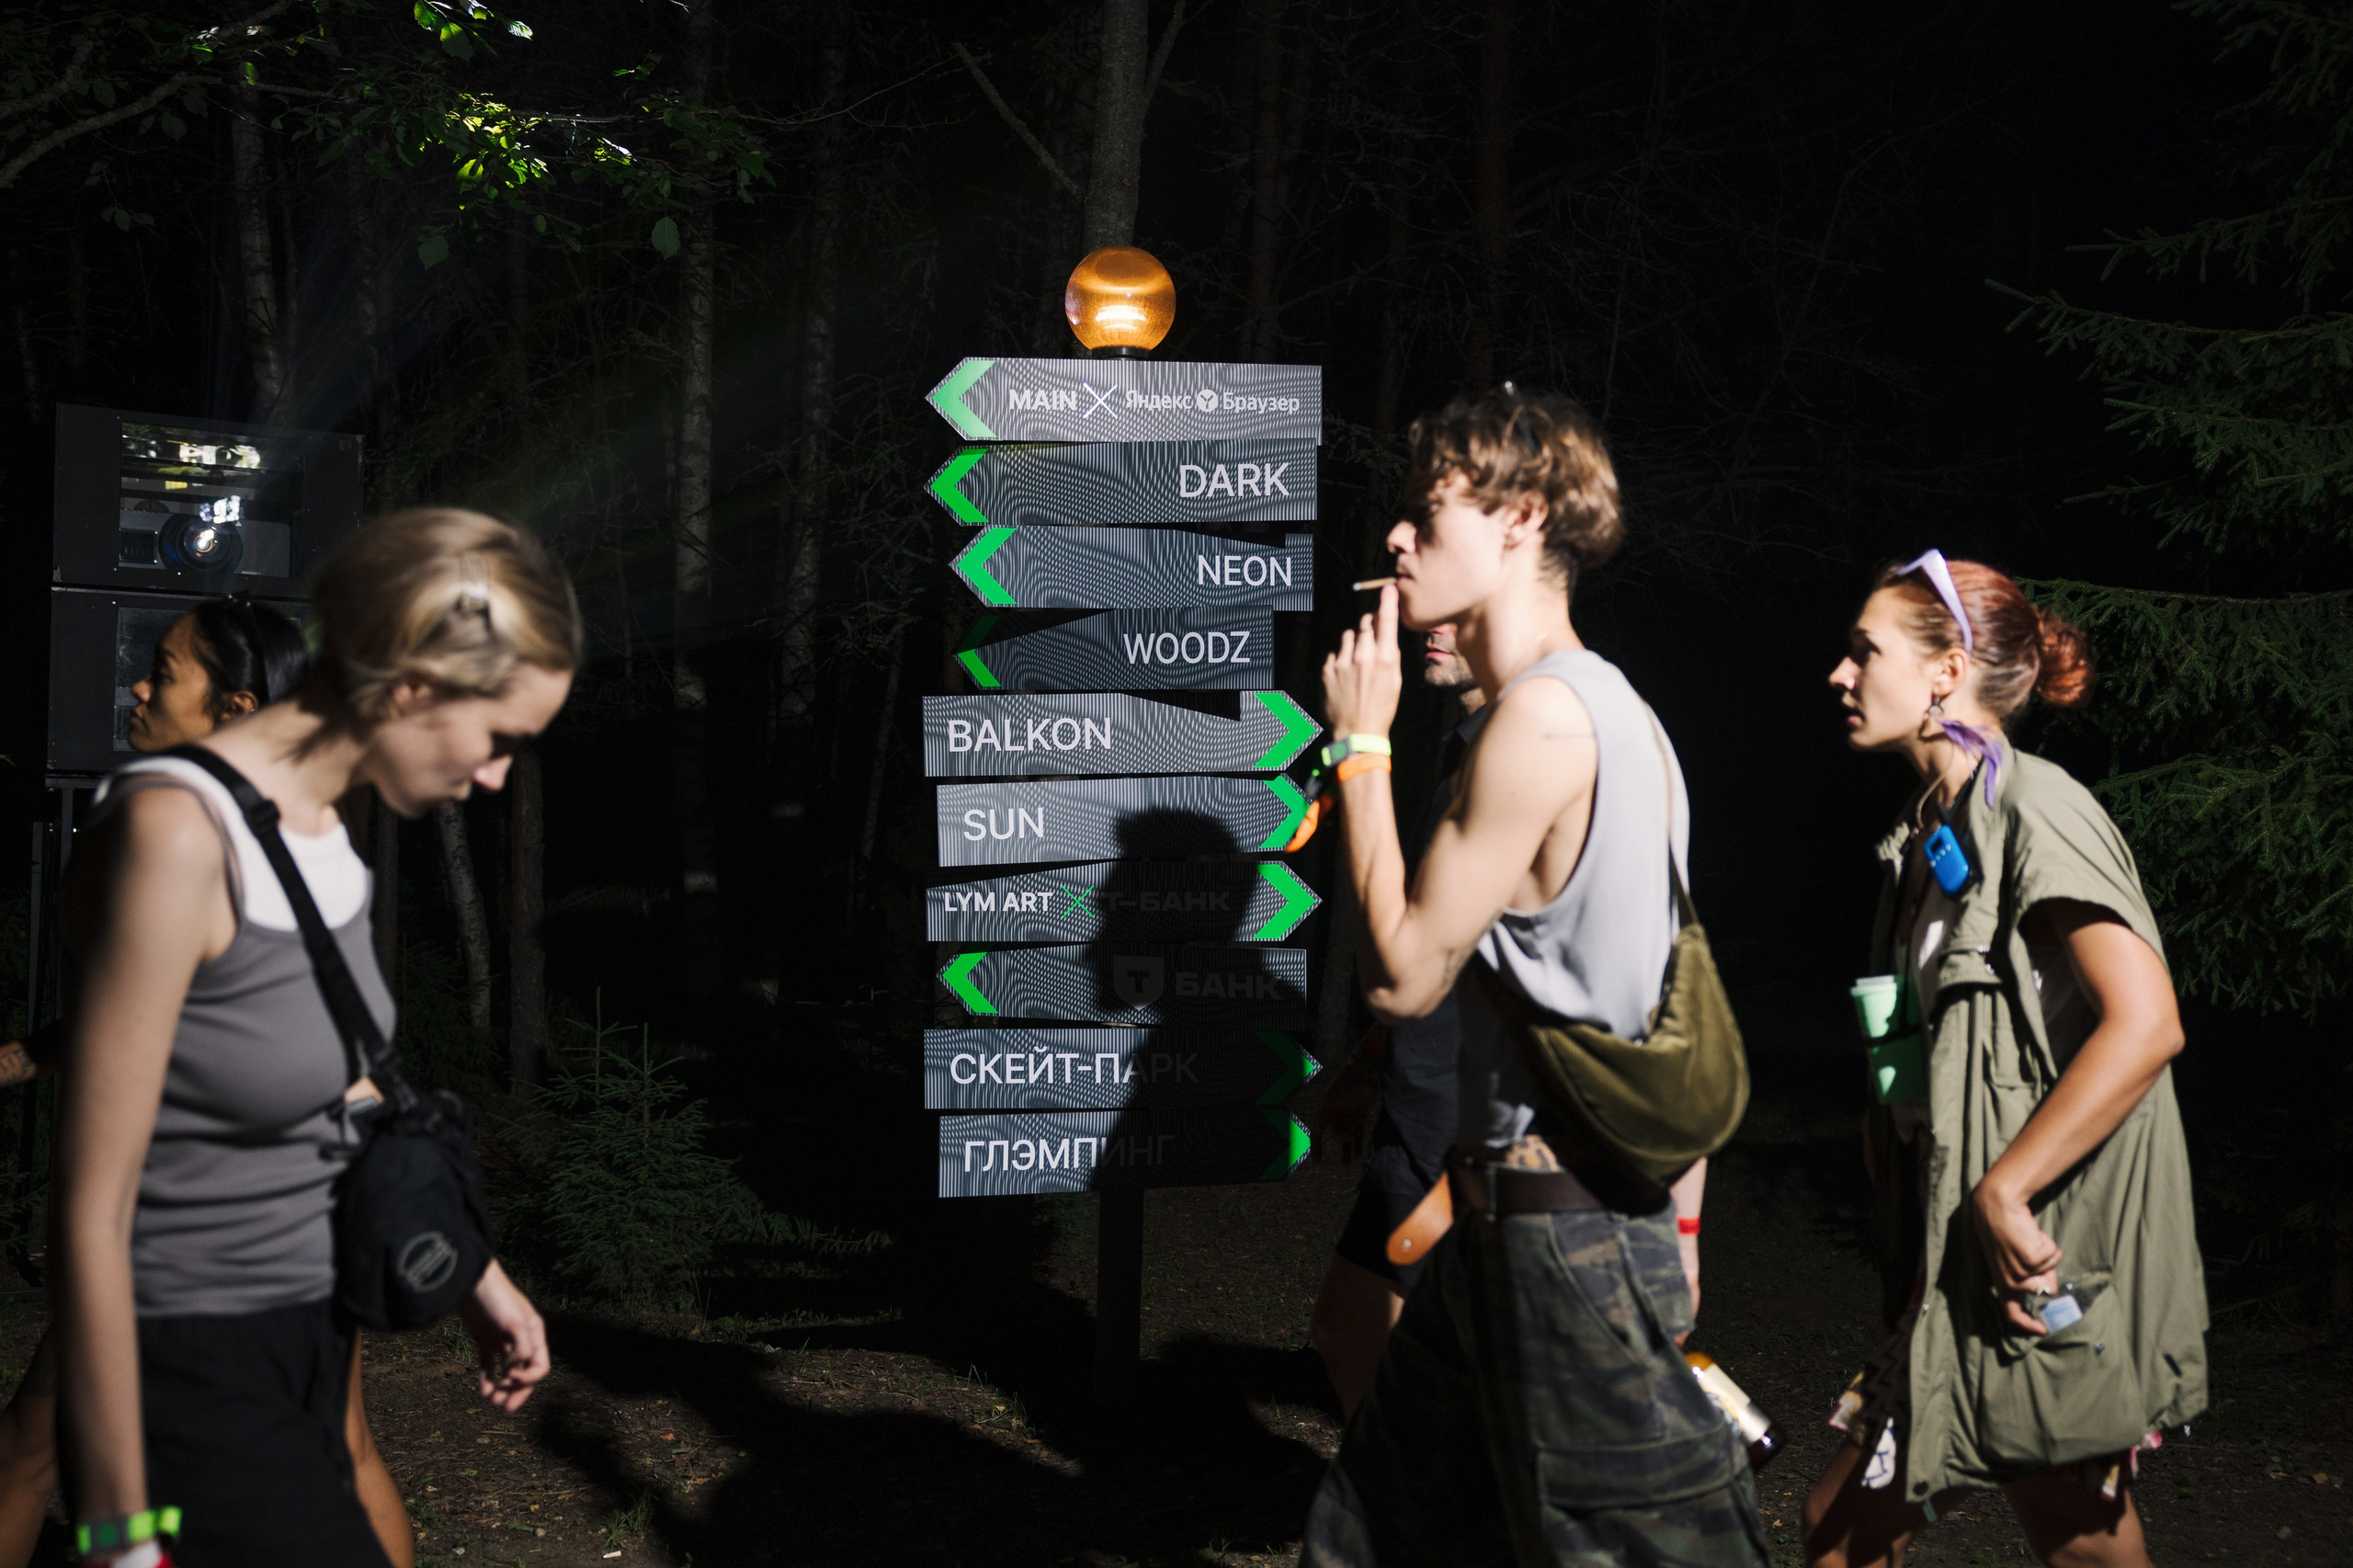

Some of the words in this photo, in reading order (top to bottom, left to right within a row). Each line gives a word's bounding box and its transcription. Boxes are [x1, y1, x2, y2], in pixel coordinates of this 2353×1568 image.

[1009, 389, 1077, 411] MAIN
[1125, 390, 1192, 411] Яндекс
[1222, 392, 1301, 413] Браузер
[1179, 462, 1290, 497] DARK
[1198, 555, 1292, 586] NEON
[1123, 631, 1251, 665] WOODZ
[948, 717, 1111, 752] BALKON
[963, 807, 1044, 841] SUN
[943, 892, 998, 913] LYM
[1002, 892, 1053, 913] ART
[1176, 971, 1282, 1000] БАНК
[950, 1046, 1199, 1085] СКЕЙТ-ПАРК
[963, 1134, 1176, 1173] ГЛЭМПИНГ
